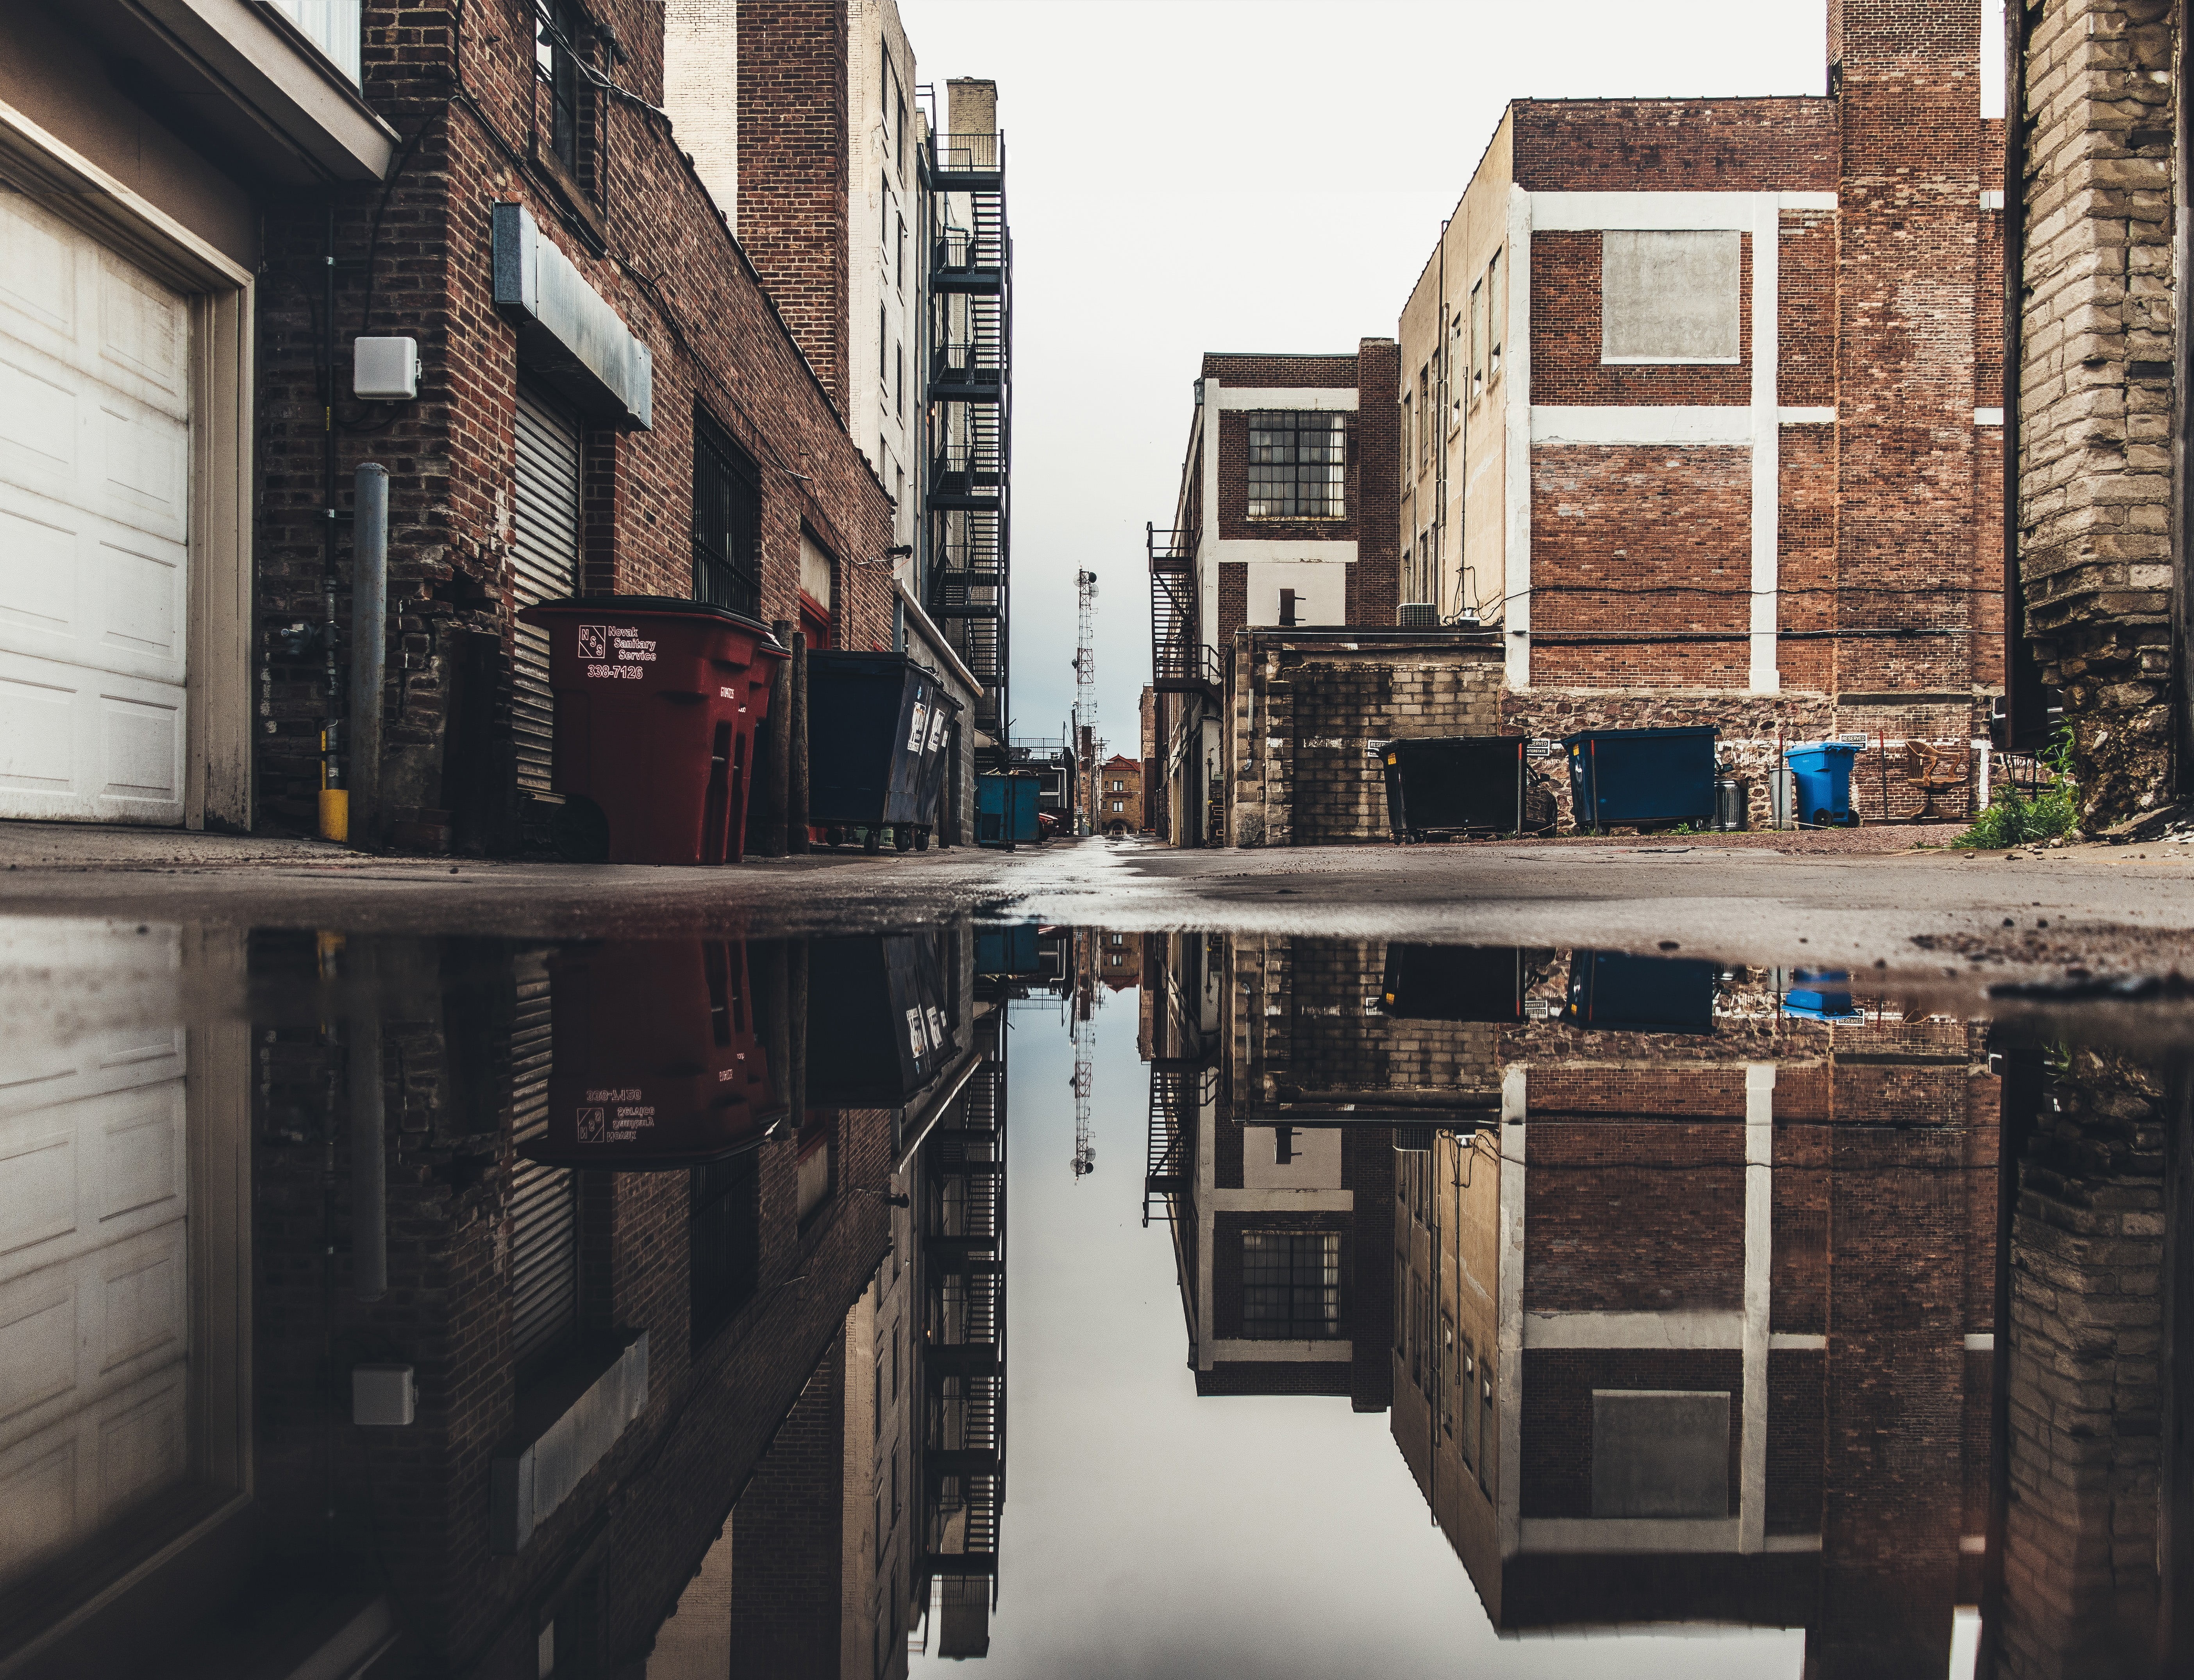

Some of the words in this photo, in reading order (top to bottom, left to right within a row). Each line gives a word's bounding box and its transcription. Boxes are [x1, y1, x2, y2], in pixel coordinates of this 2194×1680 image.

[608, 626, 638, 637] Novak
[614, 638, 656, 651] Sanitary
[618, 649, 657, 661] Service
[588, 665, 643, 679] 338-7126
